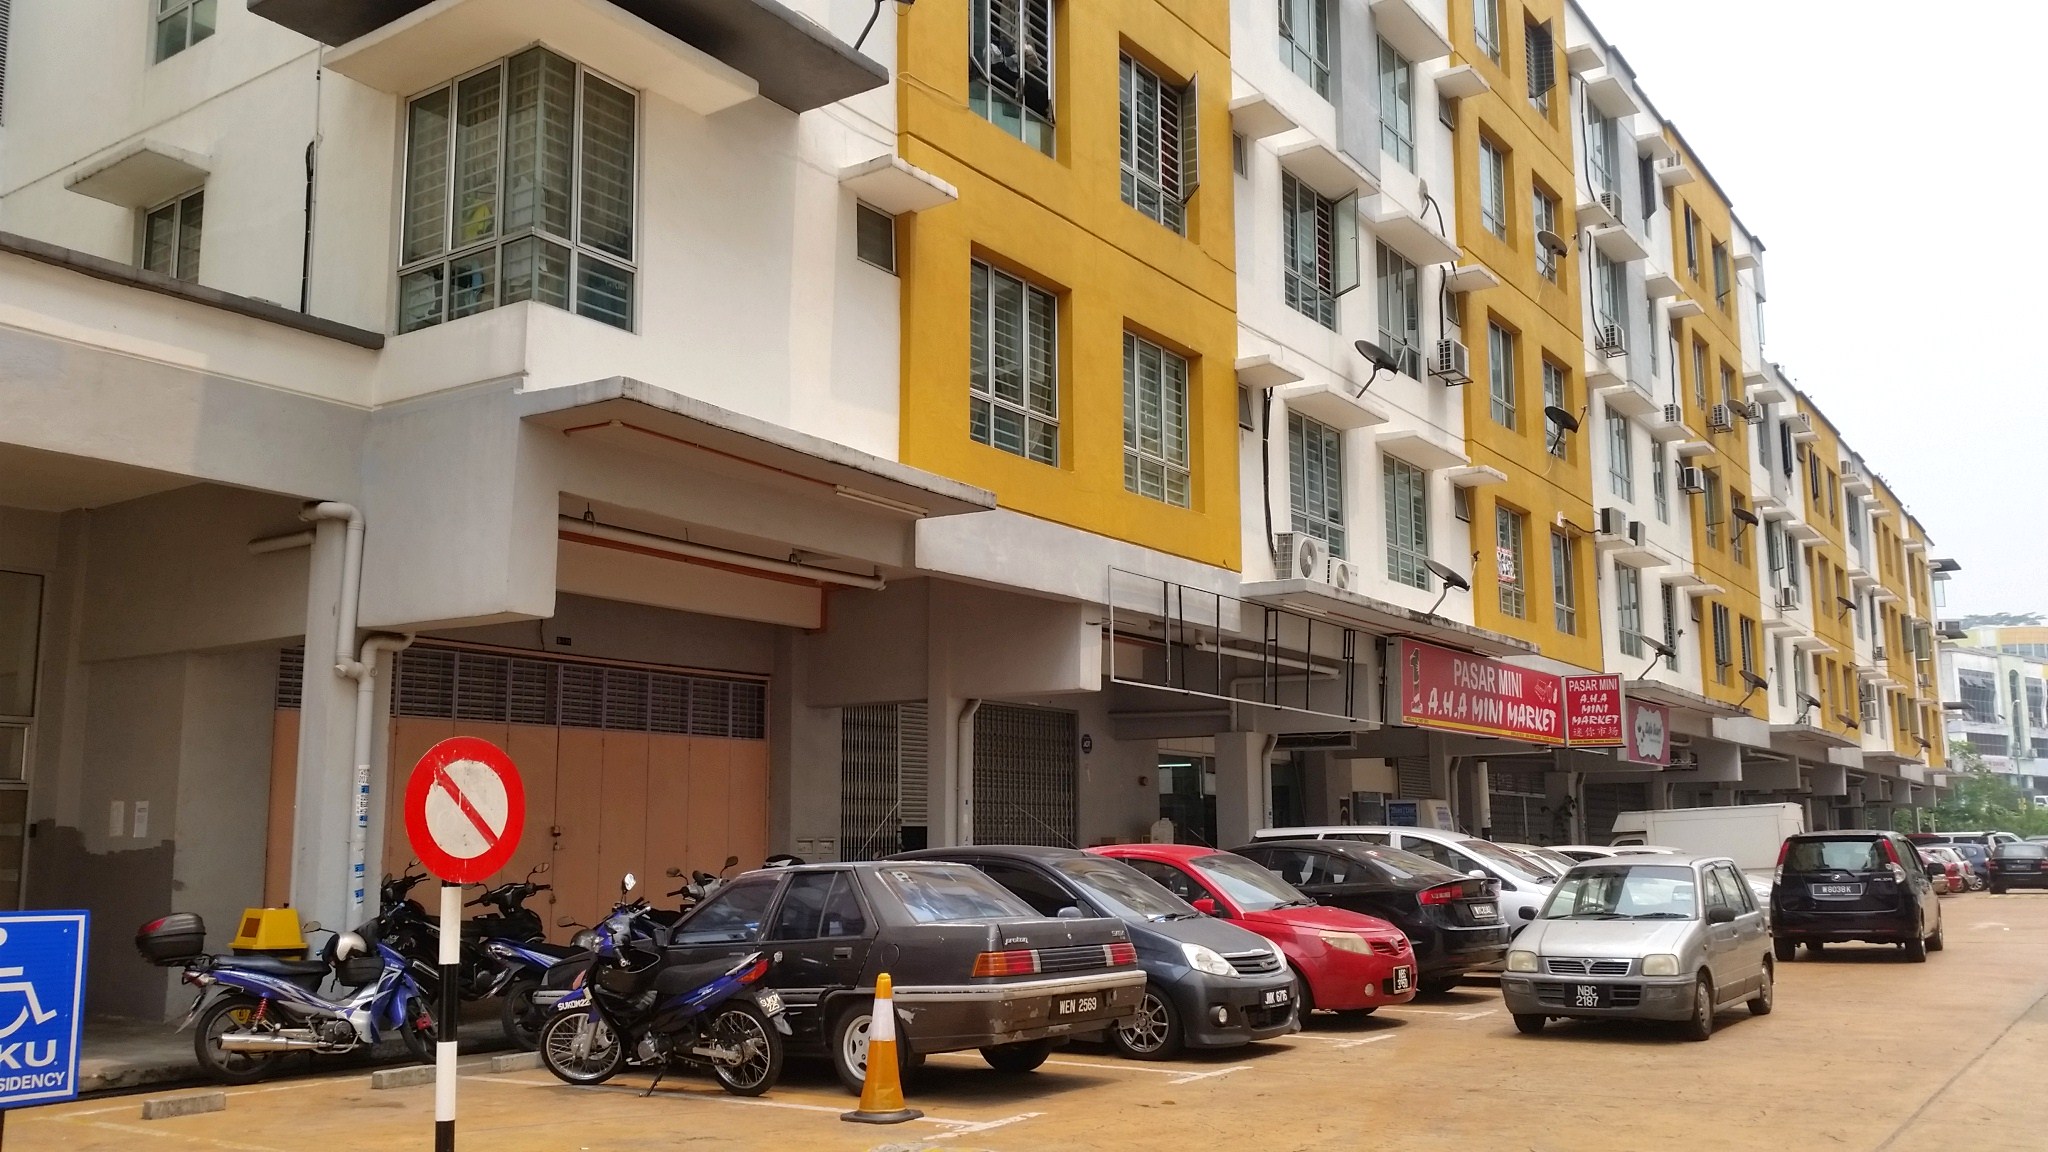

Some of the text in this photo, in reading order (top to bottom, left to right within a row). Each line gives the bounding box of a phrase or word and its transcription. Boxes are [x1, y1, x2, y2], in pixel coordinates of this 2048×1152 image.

[1453, 658, 1523, 698] PASAR MINI
[1569, 678, 1617, 692] PASAR MINI
[1580, 693, 1608, 703] A.H.A
[1428, 687, 1557, 734] A.H.A MINI MARKET
[1581, 704, 1609, 714] MINI
[1571, 714, 1619, 725] MARKET
[1573, 726, 1619, 737] 迷你市场
[1577, 985, 1597, 996] NBC
[1059, 997, 1097, 1014] WEN 2569
[1576, 996, 1599, 1007] 2187
